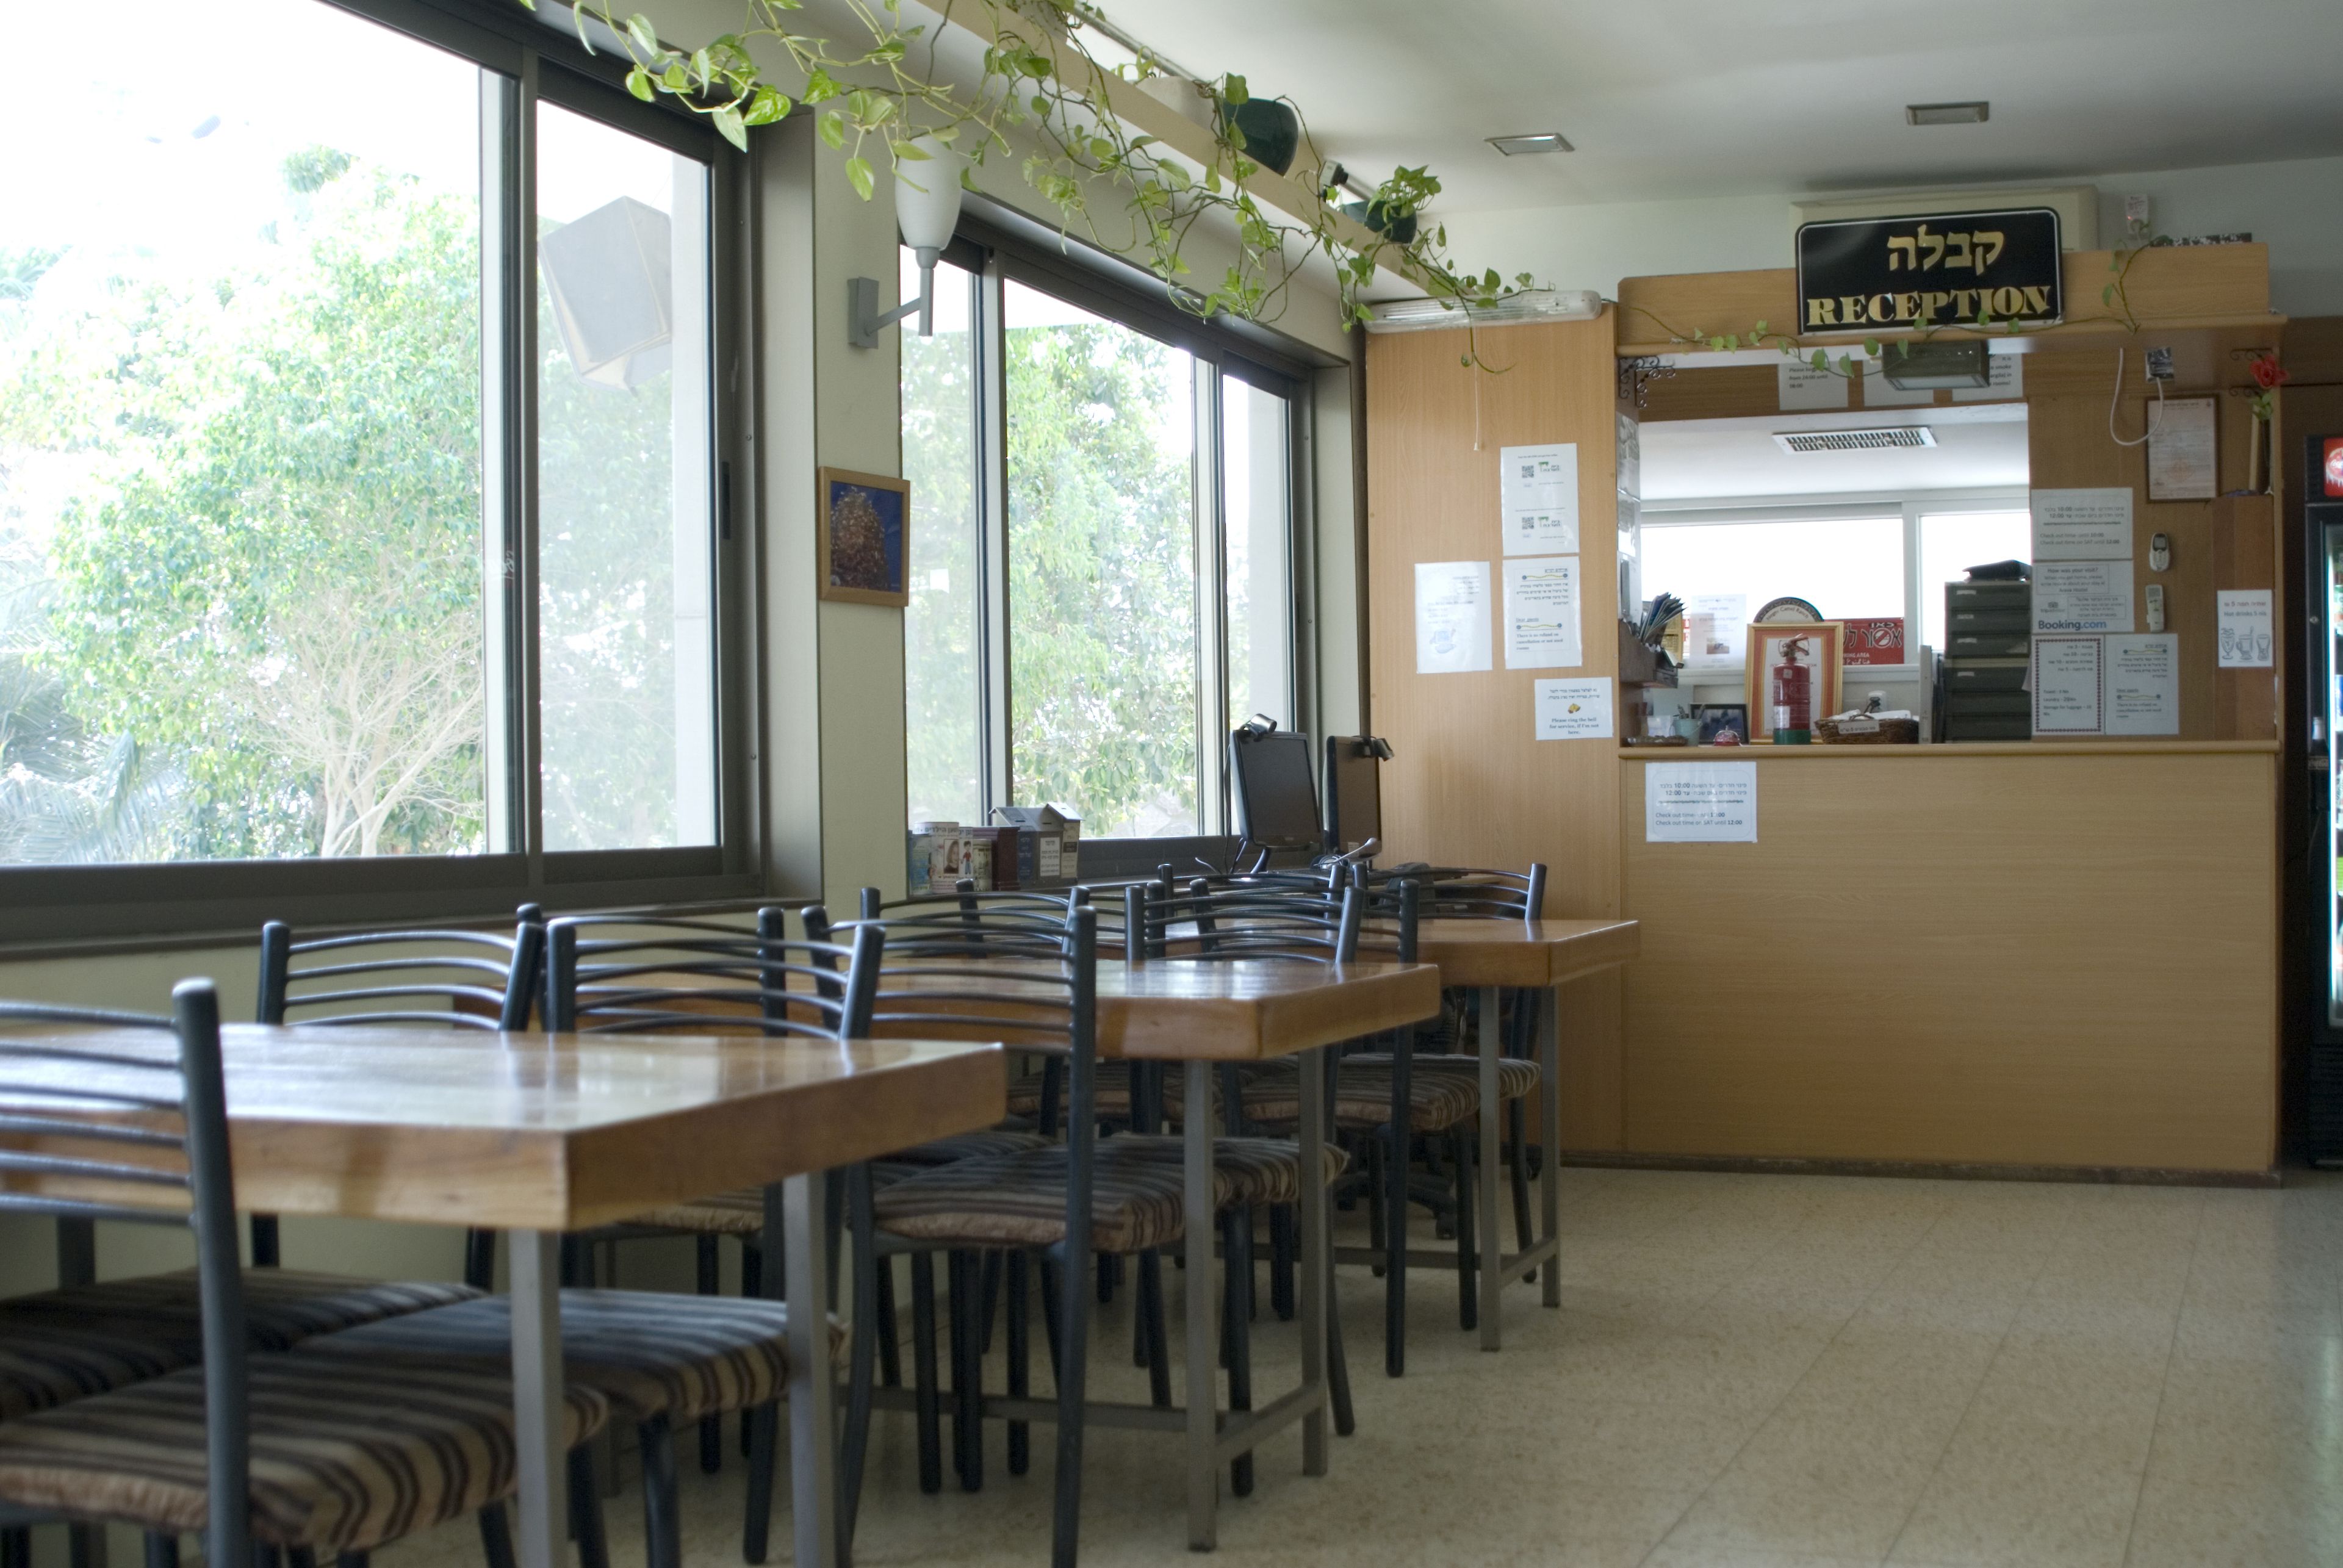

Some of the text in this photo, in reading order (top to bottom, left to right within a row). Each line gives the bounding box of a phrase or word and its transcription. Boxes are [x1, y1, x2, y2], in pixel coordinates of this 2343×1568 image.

[1888, 224, 2004, 276] קבלה
[1807, 286, 2051, 326] RECEPTION
[2038, 620, 2106, 631] Booking.com
